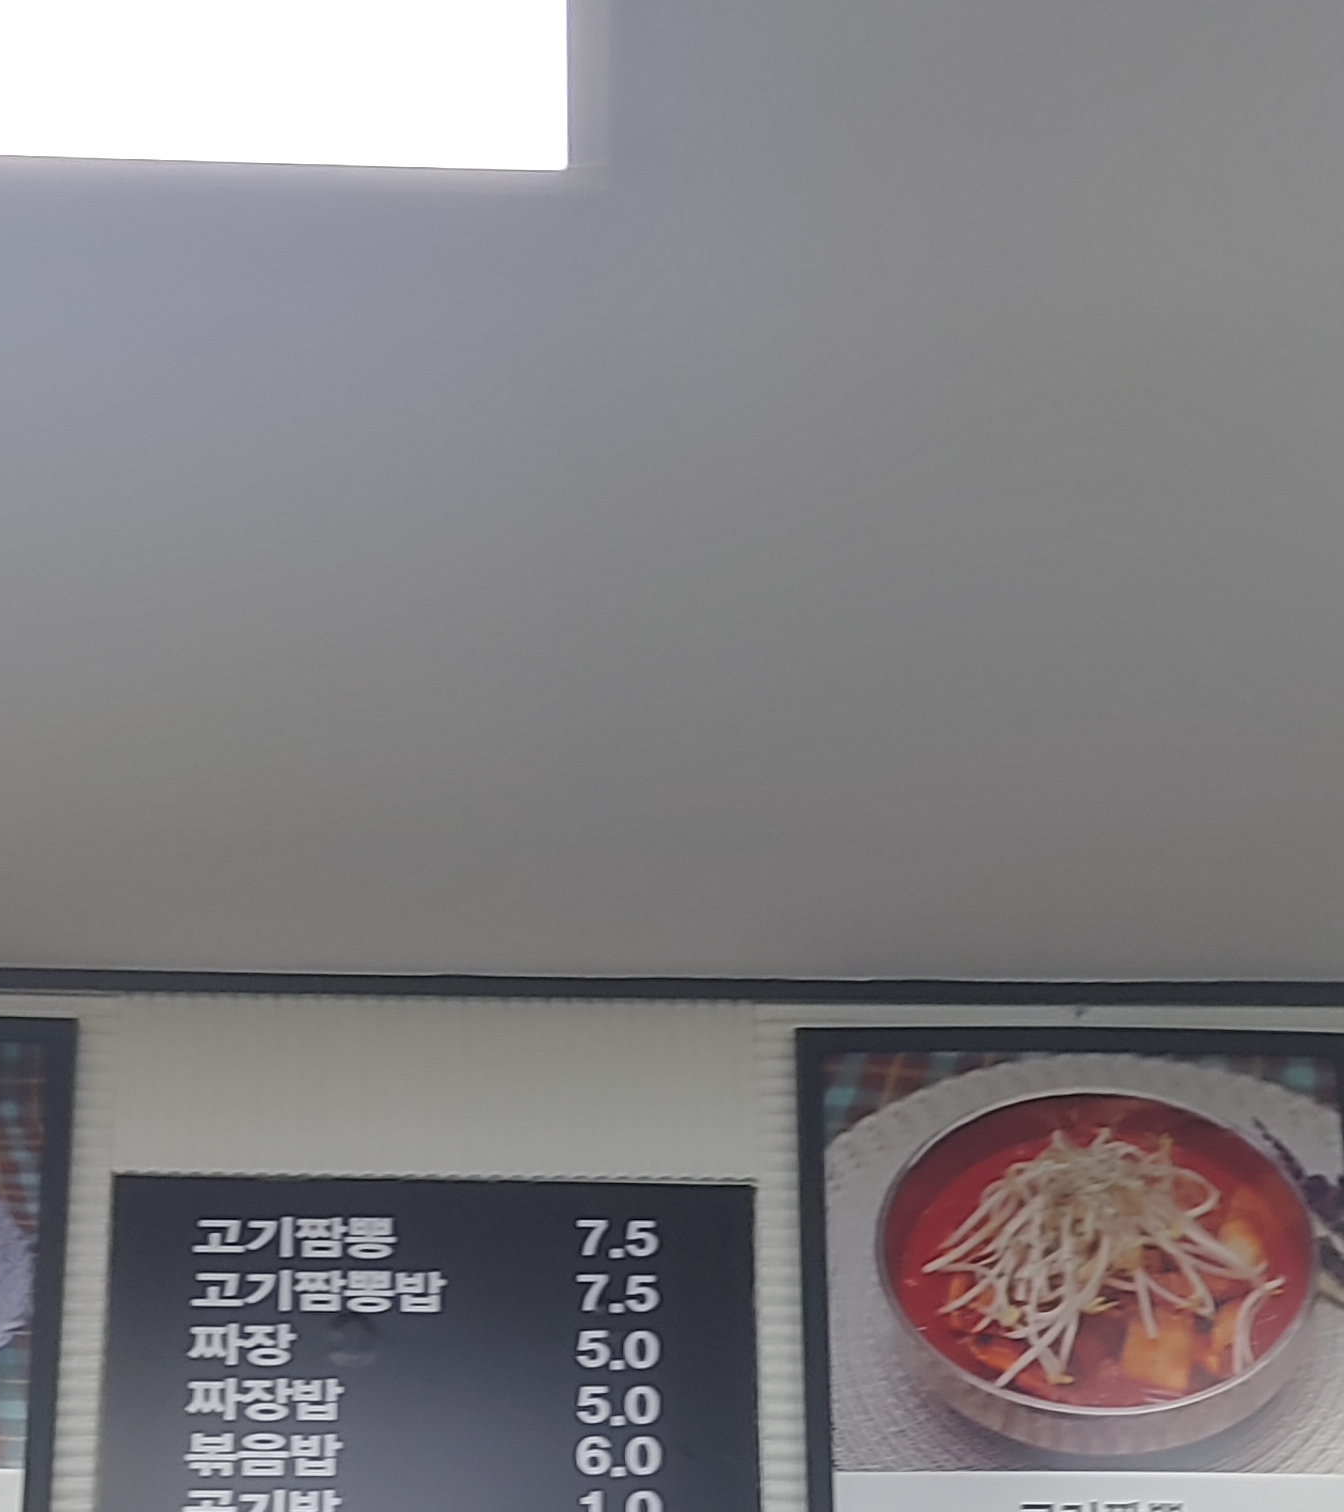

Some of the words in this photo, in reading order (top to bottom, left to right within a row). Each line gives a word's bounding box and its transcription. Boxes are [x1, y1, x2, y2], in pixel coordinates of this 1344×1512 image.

[191, 1217, 398, 1260] 고기짬뽕
[575, 1219, 659, 1259] 7.5
[189, 1270, 447, 1314] 고기짬뽕밥
[575, 1273, 660, 1314] 7.5
[188, 1324, 296, 1367] 짜장
[575, 1330, 661, 1370] 5.0
[186, 1378, 345, 1422] 짜장밥
[575, 1386, 661, 1426] 5.0
[184, 1432, 343, 1477] 볶음밥
[575, 1436, 662, 1477] 6.0
